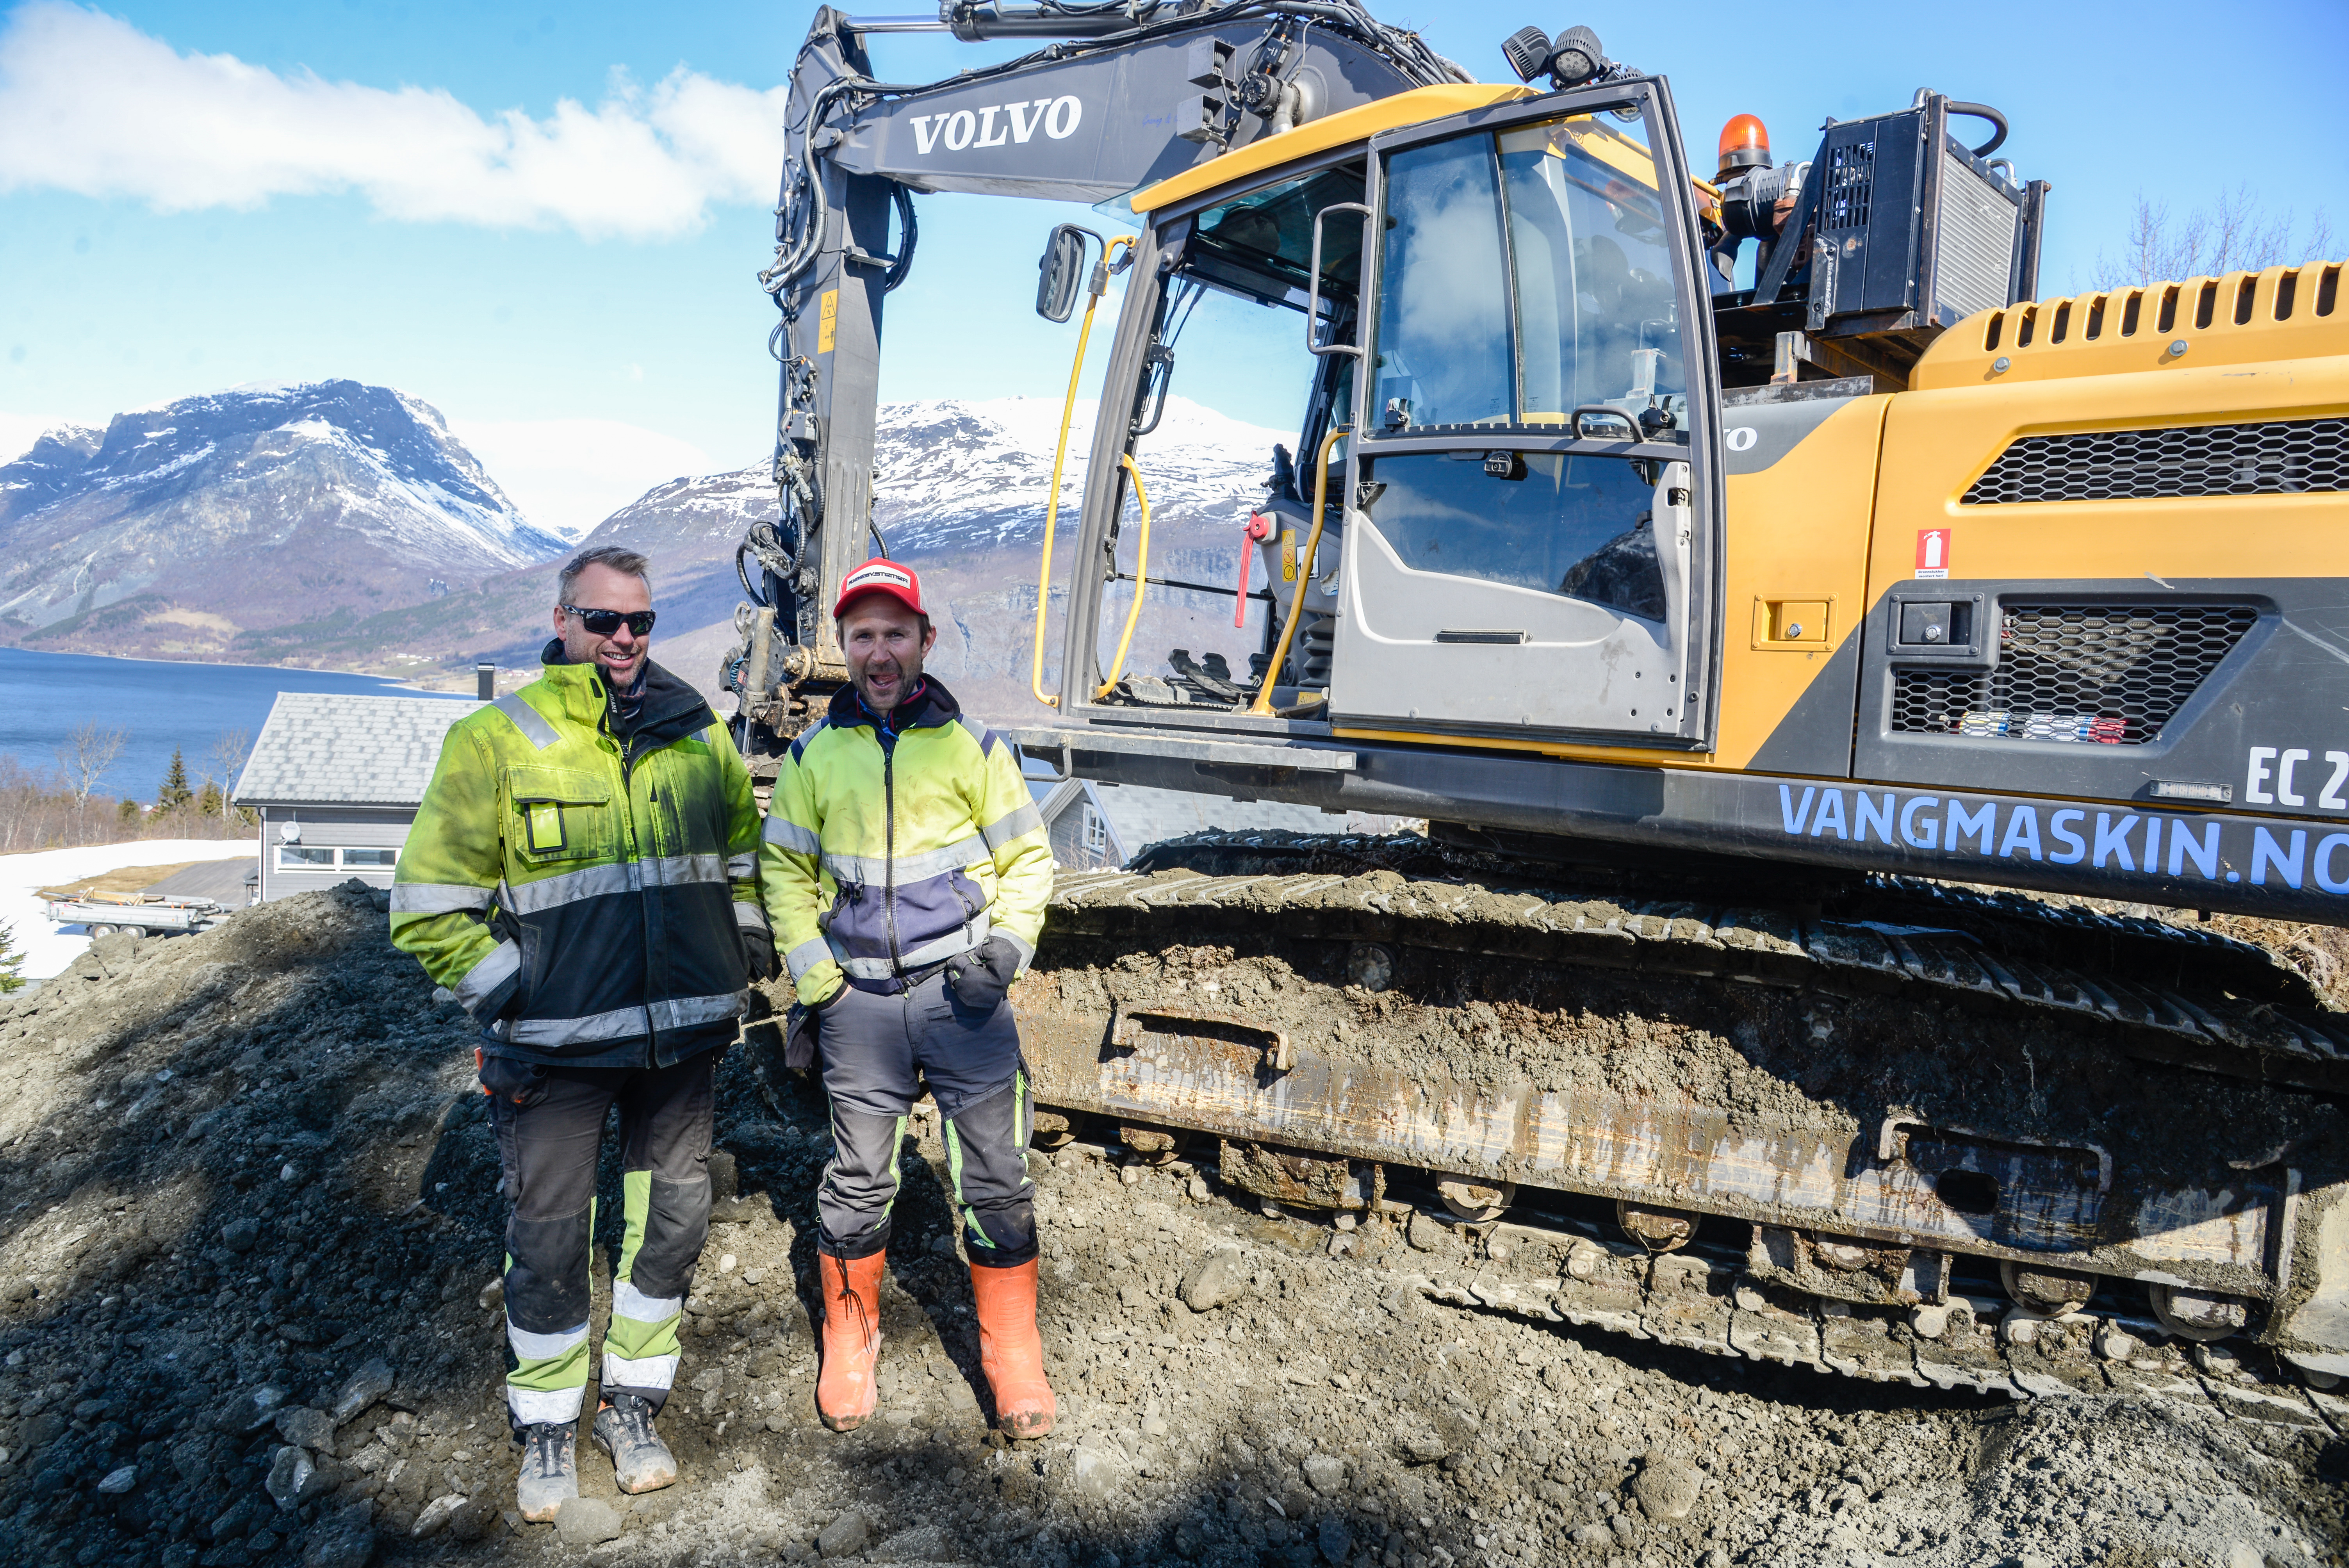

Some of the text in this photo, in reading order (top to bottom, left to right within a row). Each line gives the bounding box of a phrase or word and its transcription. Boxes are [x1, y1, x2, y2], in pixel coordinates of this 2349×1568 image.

[909, 95, 1082, 155] VOLVO
[1723, 426, 1757, 451] O
[1779, 784, 2349, 894] VANGMASKIN.NO
